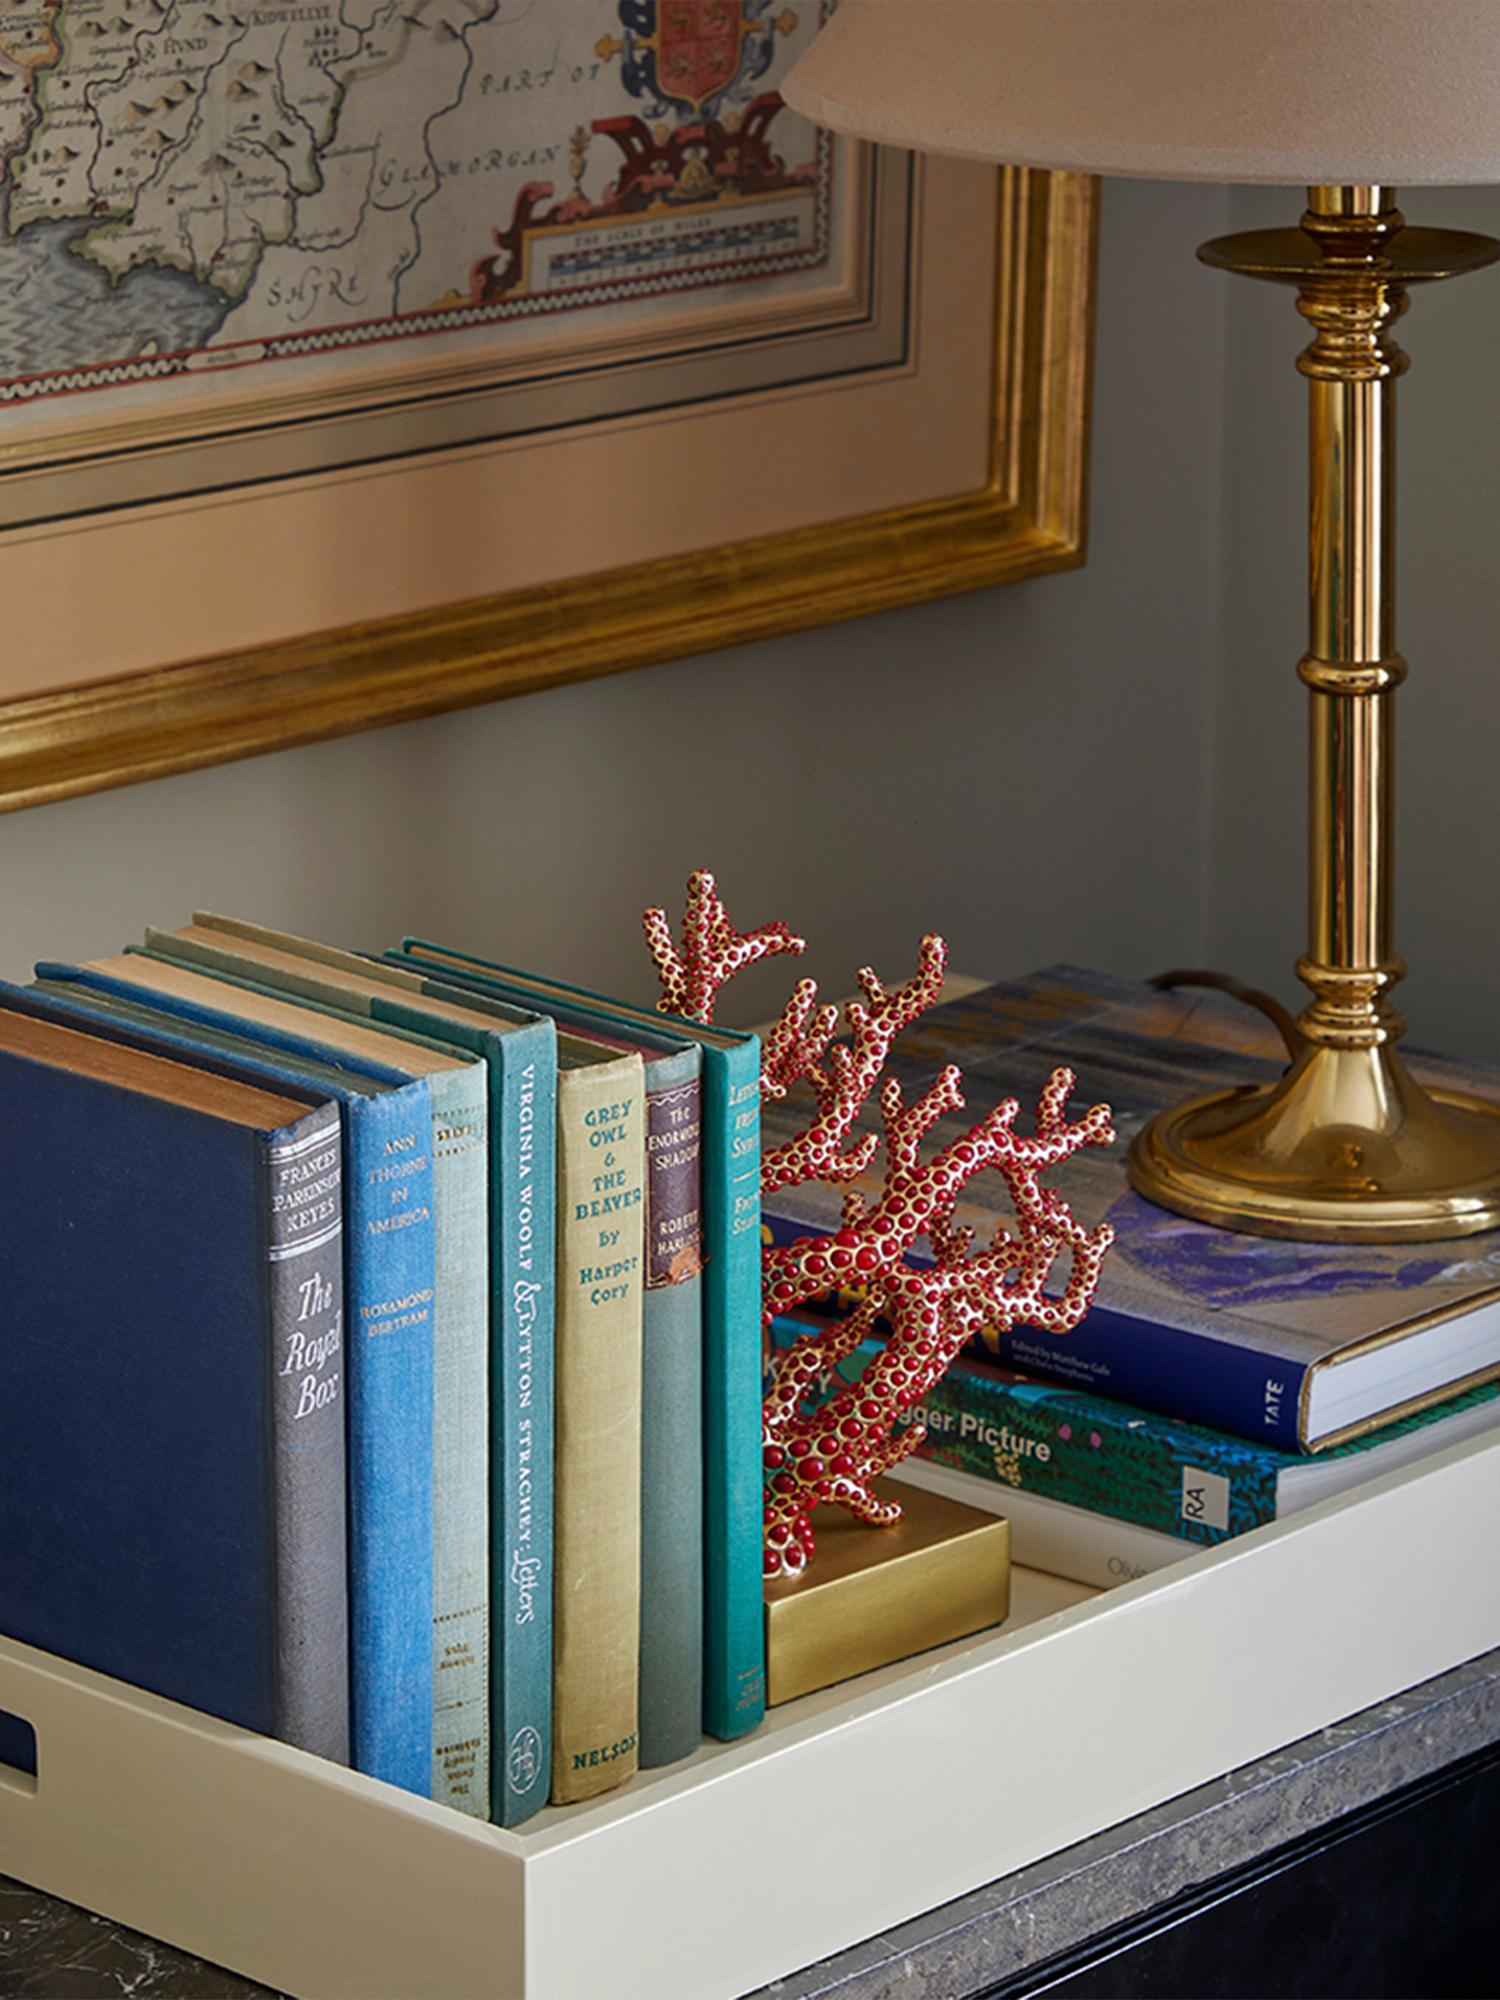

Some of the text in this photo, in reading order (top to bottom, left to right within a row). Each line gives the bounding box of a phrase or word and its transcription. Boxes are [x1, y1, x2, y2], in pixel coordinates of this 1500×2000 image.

[519, 1064, 534, 1179] VIRGINIA
[584, 1099, 632, 1126] GREY
[383, 1134, 416, 1157] ANN
[589, 1124, 628, 1147] OWL
[279, 1150, 337, 1188] FRANCES
[367, 1156, 427, 1186] THORNE
[593, 1169, 626, 1193] THE
[391, 1188, 408, 1205] IN
[574, 1187, 642, 1221] BEAVER
[286, 1198, 335, 1233] KEYES
[364, 1207, 430, 1237] AMERICA
[518, 1184, 533, 1270] WOOLF
[599, 1230, 621, 1249] by
[579, 1256, 638, 1285] Harper
[298, 1272, 333, 1322] The
[359, 1288, 434, 1321] ROSAMOND
[590, 1284, 629, 1306] Cory
[368, 1309, 428, 1338] BERTRAM
[278, 1310, 341, 1377] Royal
[519, 1310, 532, 1408] LYTTON
[293, 1374, 339, 1420] Box
[1264, 1379, 1284, 1425] TATE
[897, 1403, 1050, 1462] gger Picture
[1185, 1488, 1205, 1519] RA
[511, 1550, 541, 1626] Letters
